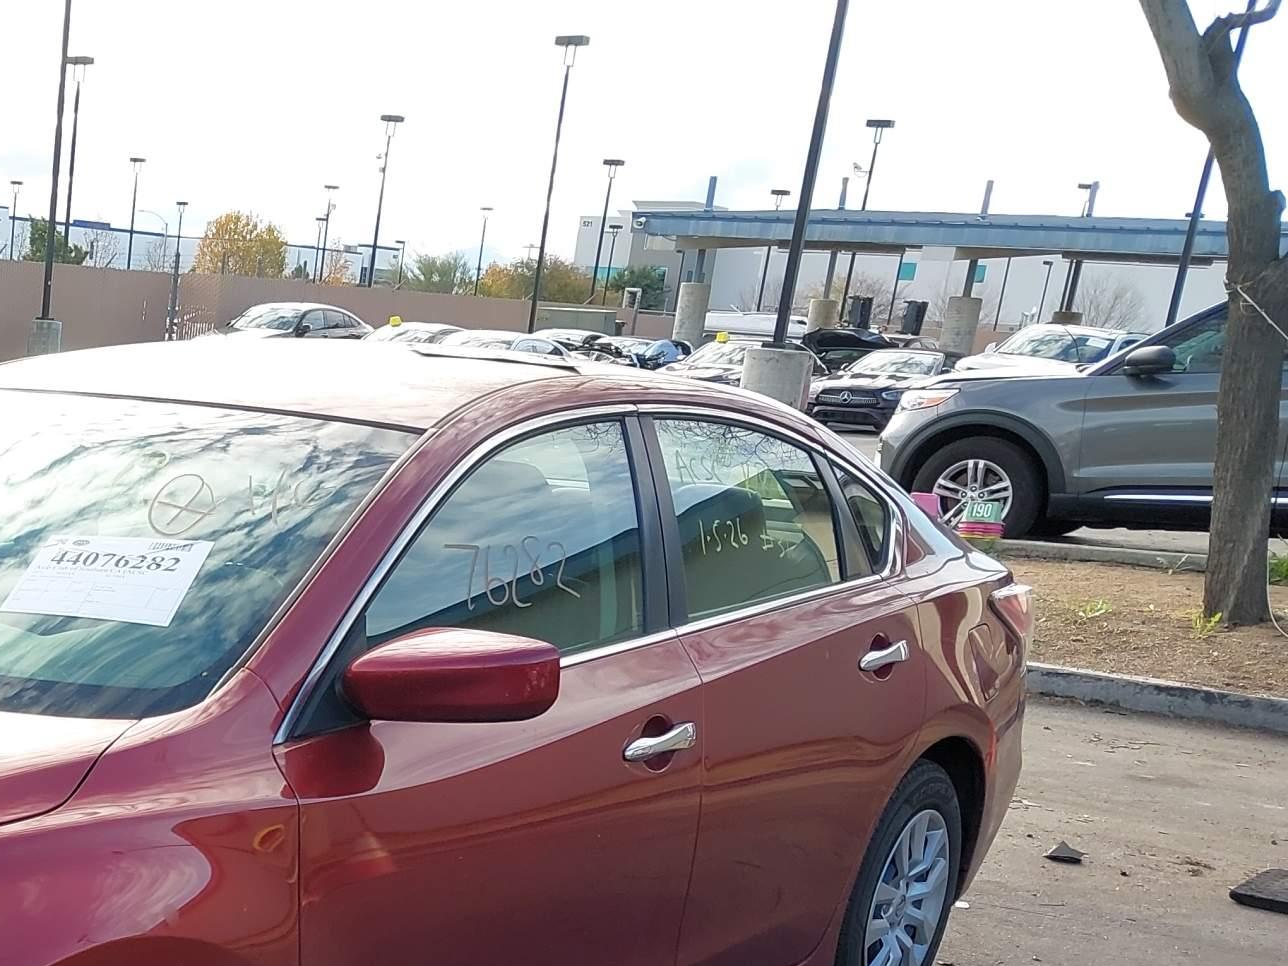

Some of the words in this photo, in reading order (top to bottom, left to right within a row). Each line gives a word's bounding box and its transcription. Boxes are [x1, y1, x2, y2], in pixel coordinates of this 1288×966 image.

[971, 502, 993, 519] 190
[50, 550, 182, 573] 44076282
[443, 535, 581, 611] 76282
